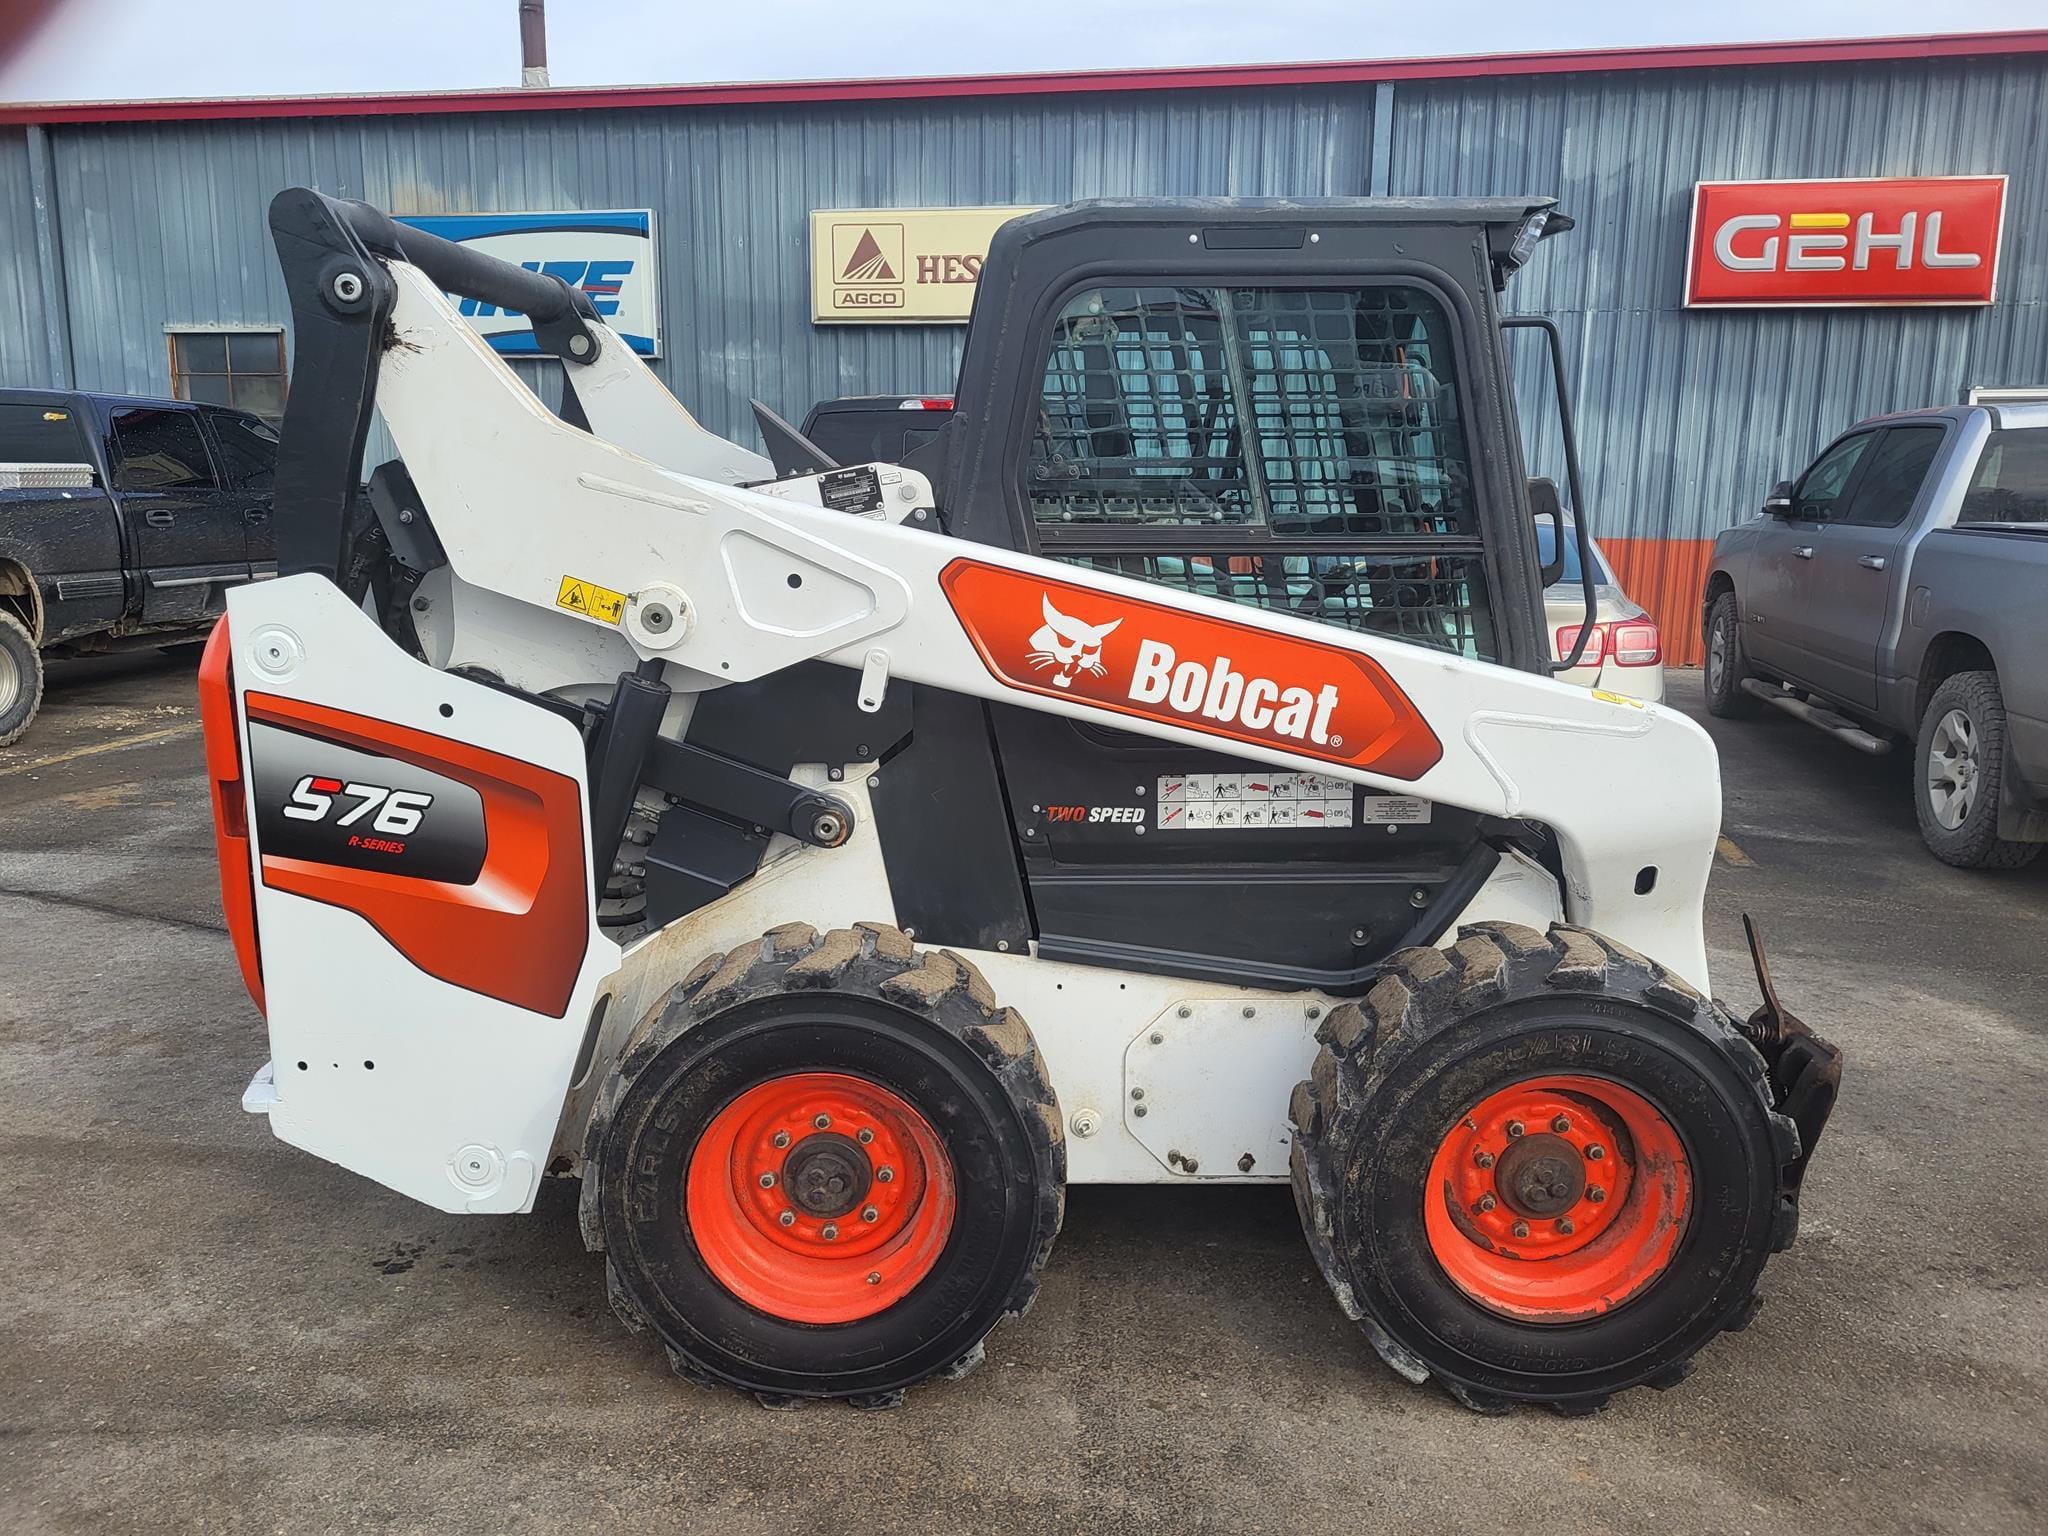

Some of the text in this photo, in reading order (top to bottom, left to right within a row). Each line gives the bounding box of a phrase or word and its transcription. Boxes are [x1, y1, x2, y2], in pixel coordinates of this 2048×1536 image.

[1713, 210, 1982, 272] GEHL
[841, 292, 897, 305] AGCO
[1127, 638, 1340, 745] Bobcat
[283, 776, 435, 836] S76
[1046, 806, 1146, 823] TWO SPEED
[348, 835, 405, 854] R-SERIES
